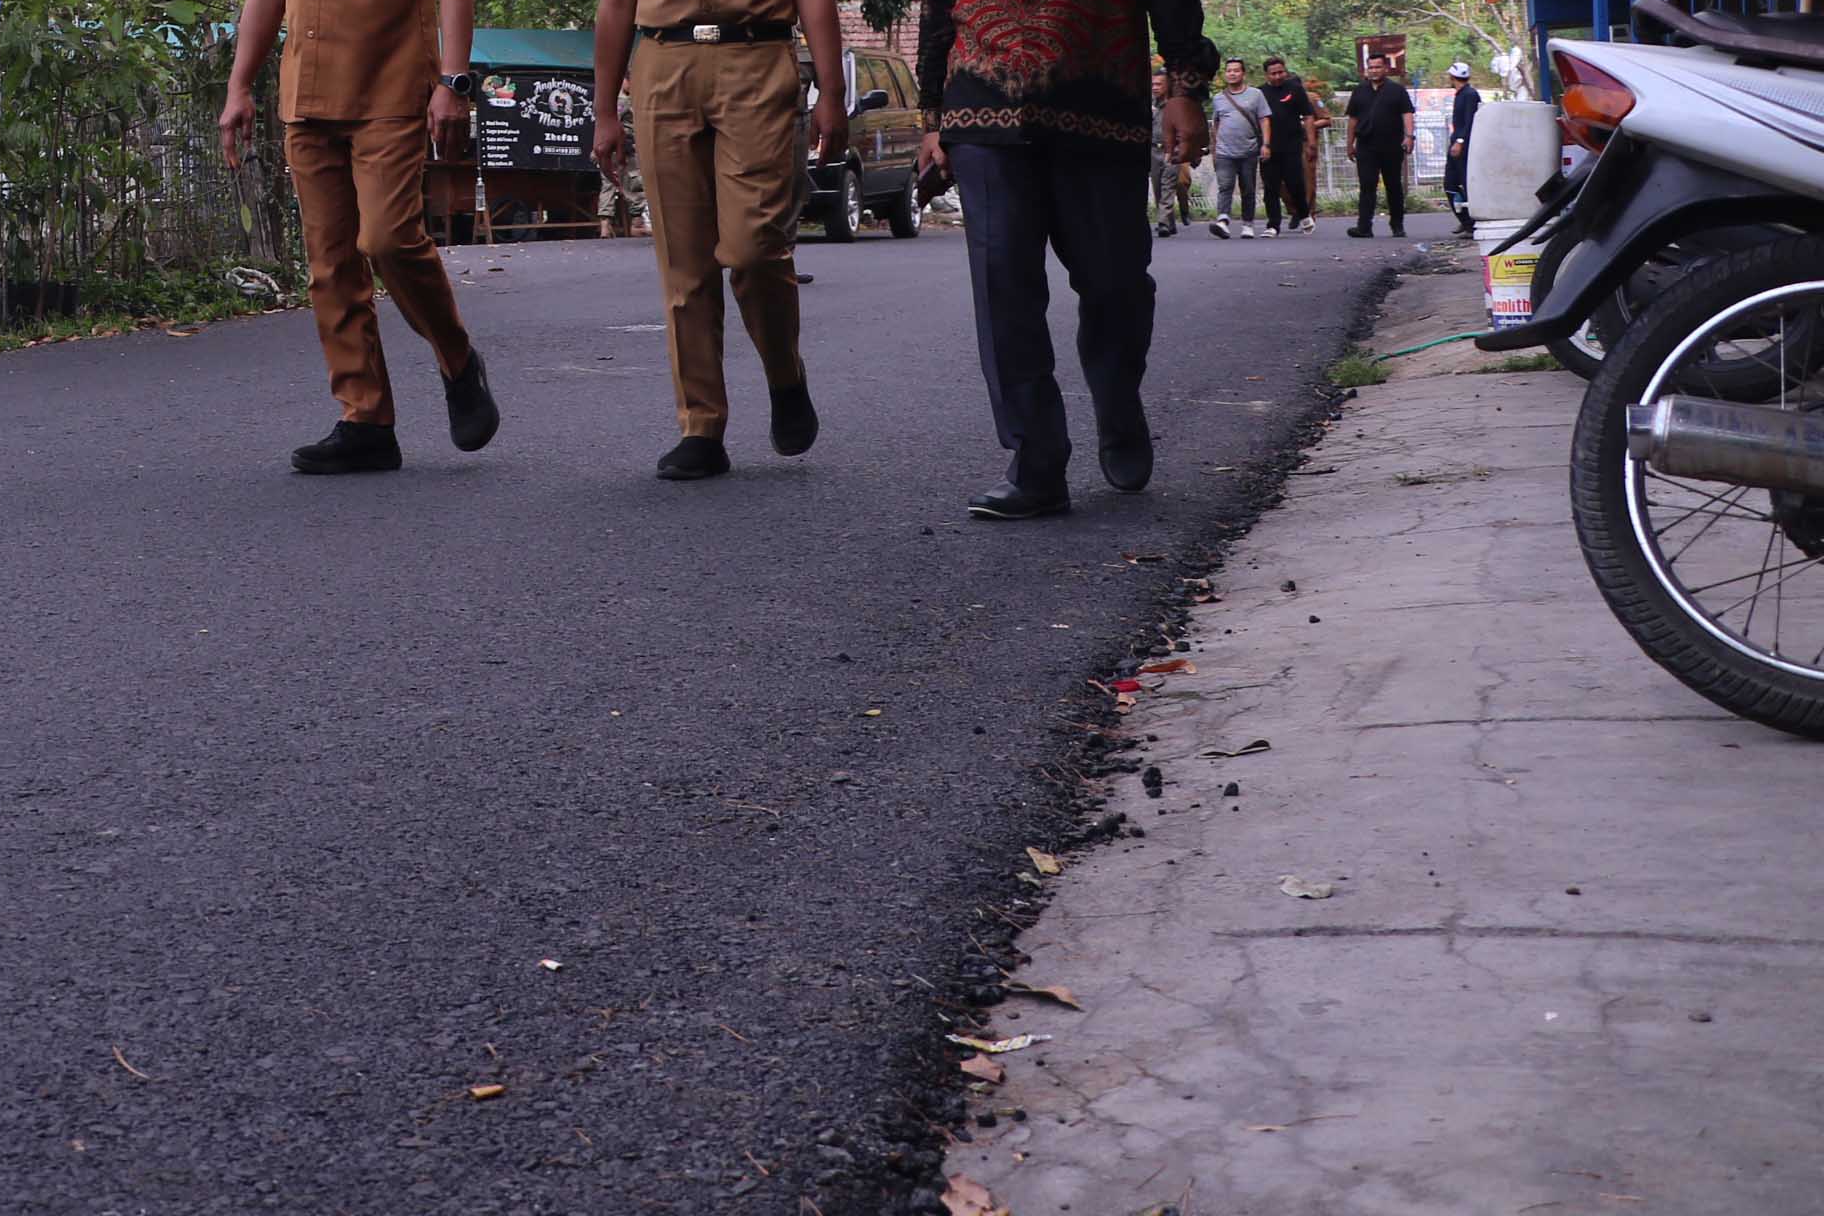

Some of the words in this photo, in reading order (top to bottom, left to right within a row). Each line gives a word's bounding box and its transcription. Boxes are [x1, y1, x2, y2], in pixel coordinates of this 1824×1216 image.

[533, 77, 588, 96] Angkringan
[538, 111, 561, 127] Mas
[564, 115, 585, 129] Bro
